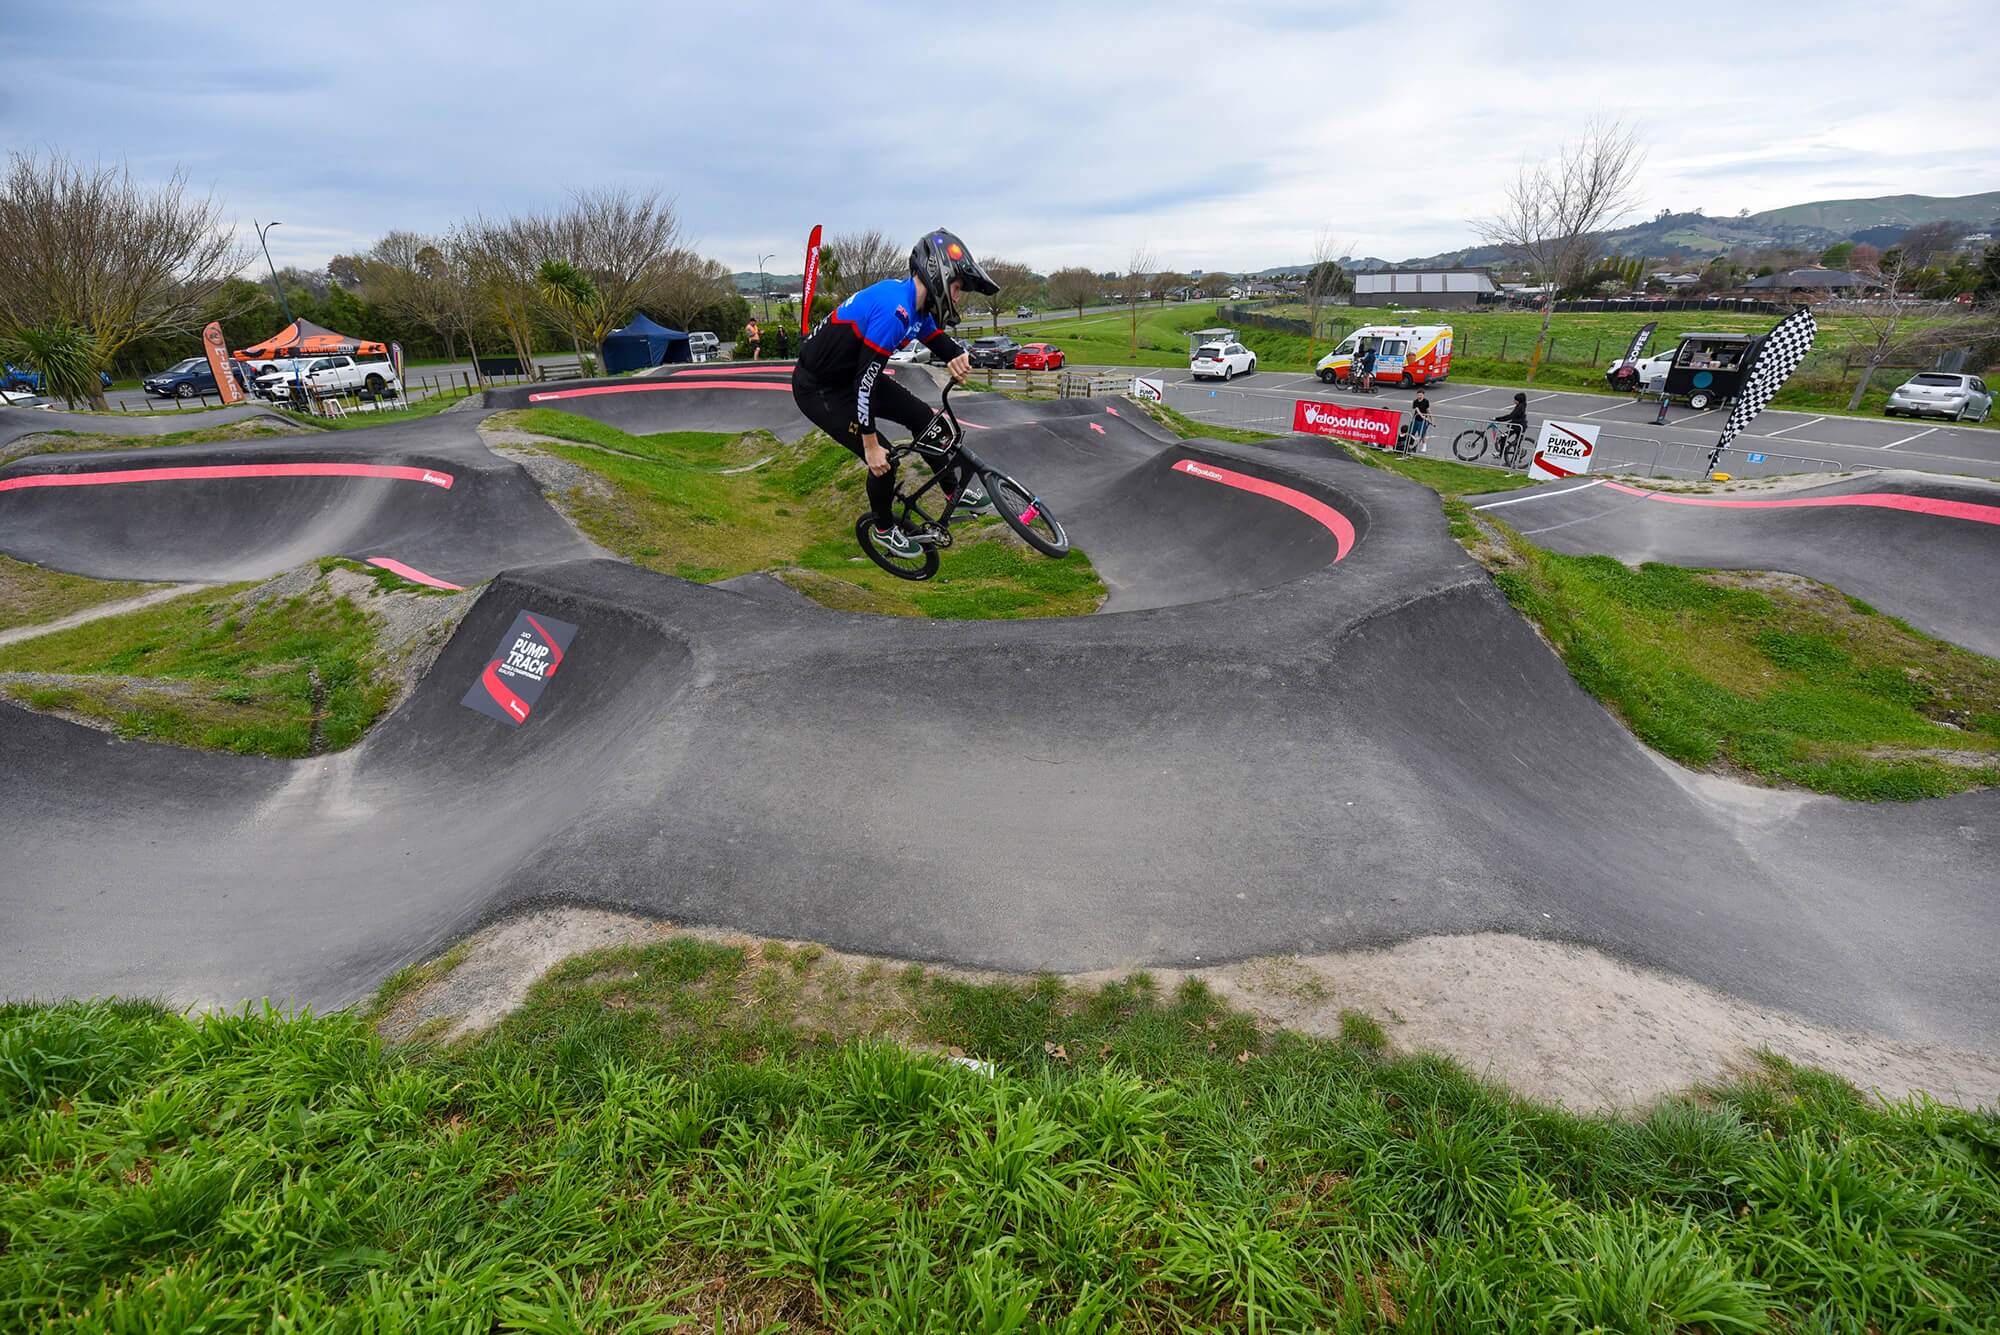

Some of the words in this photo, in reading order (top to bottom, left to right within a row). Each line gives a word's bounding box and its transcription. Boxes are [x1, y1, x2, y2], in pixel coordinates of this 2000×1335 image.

[1303, 404, 1390, 435] Velosolutions
[927, 425, 942, 439] 35
[1547, 445, 1582, 457] TRACK
[1548, 437, 1578, 448] PUMP
[512, 638, 549, 659] PUMP
[506, 650, 549, 676] TRACK
